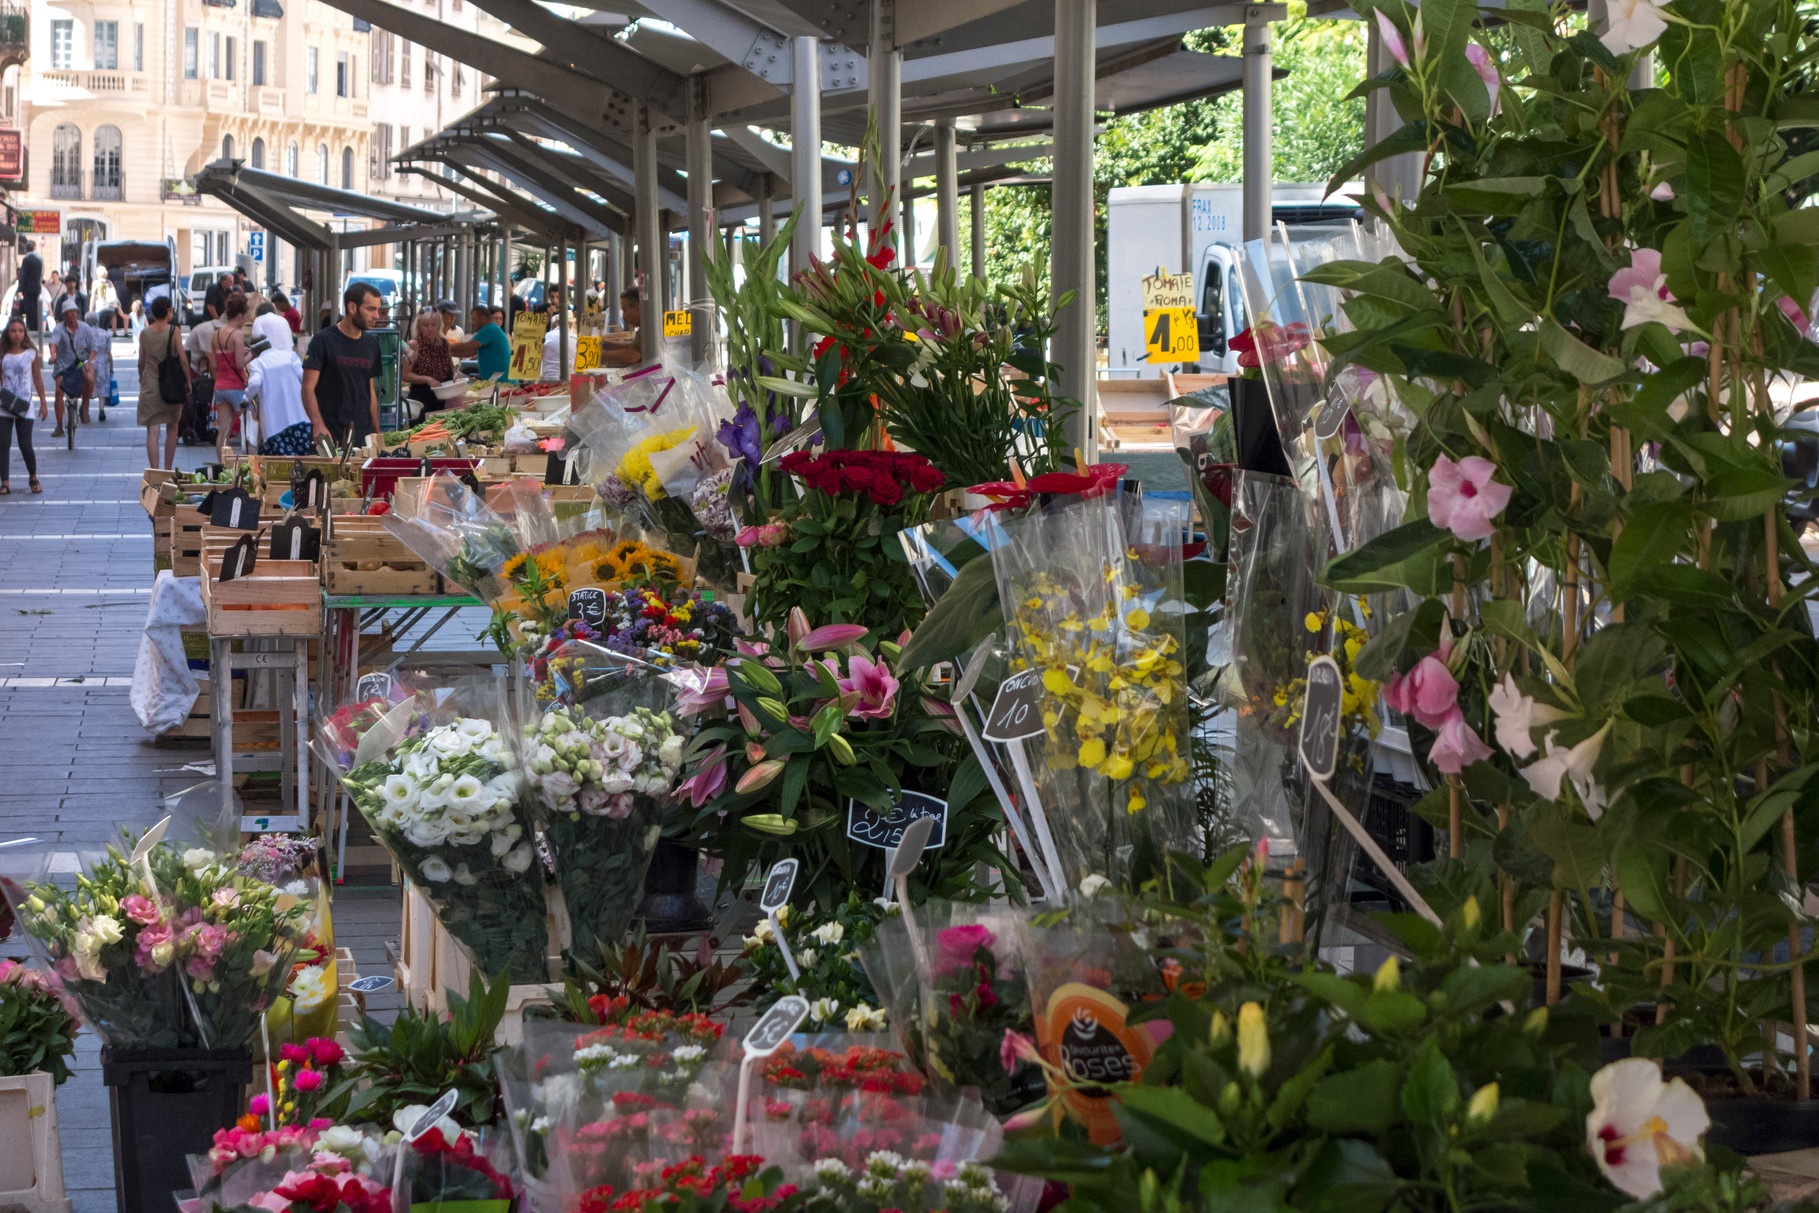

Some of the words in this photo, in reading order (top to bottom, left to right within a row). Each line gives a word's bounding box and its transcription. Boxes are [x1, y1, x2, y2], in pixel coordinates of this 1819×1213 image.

[1192, 199, 1212, 214] FRAX
[1192, 216, 1202, 231] 12
[1207, 215, 1226, 231] 2008
[1142, 274, 1193, 294] TOMATE
[514, 311, 548, 326] TOMATE
[1149, 313, 1194, 354] 1,00
[512, 344, 540, 375] 1,50
[577, 341, 599, 370] 3,20
[1058, 1044, 1142, 1079] Roses
